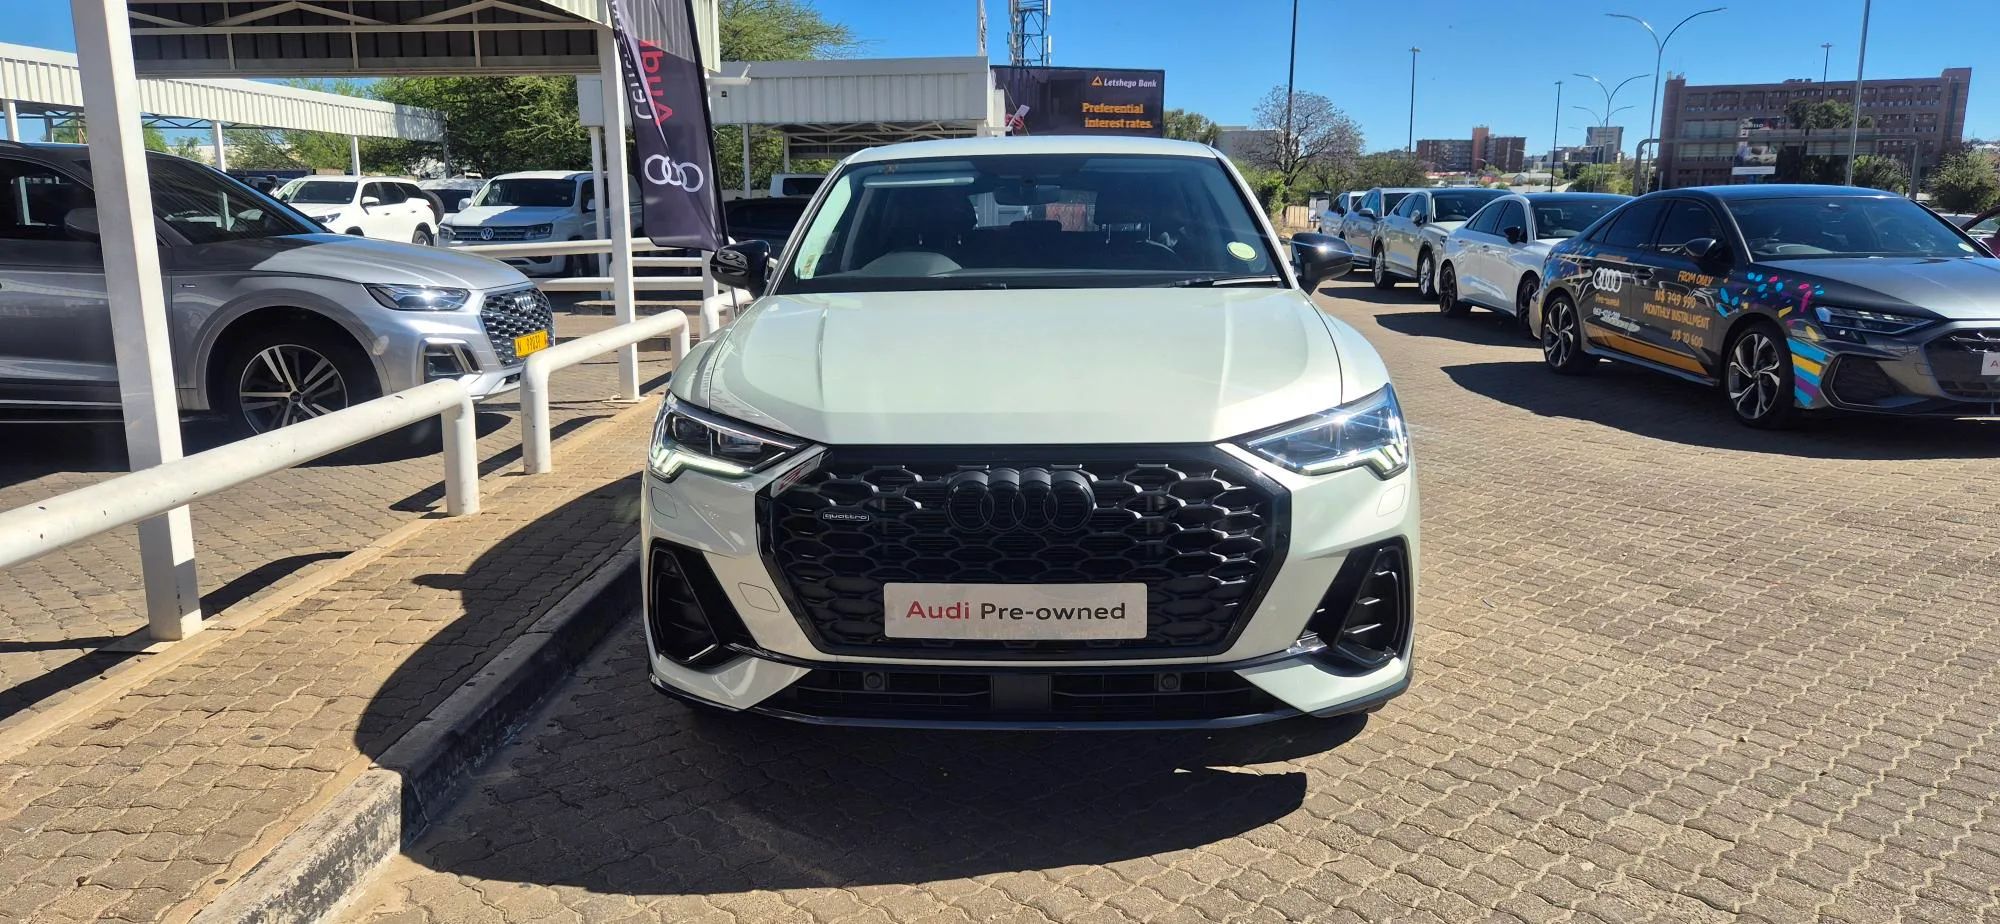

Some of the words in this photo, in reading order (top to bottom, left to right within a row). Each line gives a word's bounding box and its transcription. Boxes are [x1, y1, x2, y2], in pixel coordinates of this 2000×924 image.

[1104, 78, 1137, 89] Letshego
[1138, 79, 1157, 88] Bank
[1082, 102, 1144, 114] Preferential
[1085, 117, 1124, 128] interest
[1678, 271, 1697, 284] FROM
[1696, 274, 1714, 286] ONLY
[1655, 288, 1665, 303] N$
[1667, 291, 1681, 306] 749
[1683, 295, 1697, 309] 990
[1643, 302, 1671, 319] MONTHLY
[1671, 308, 1710, 329] INSTALLMENT
[824, 512, 868, 521] quattro
[906, 601, 970, 620] Audi
[980, 603, 1126, 620] Pre-owned
